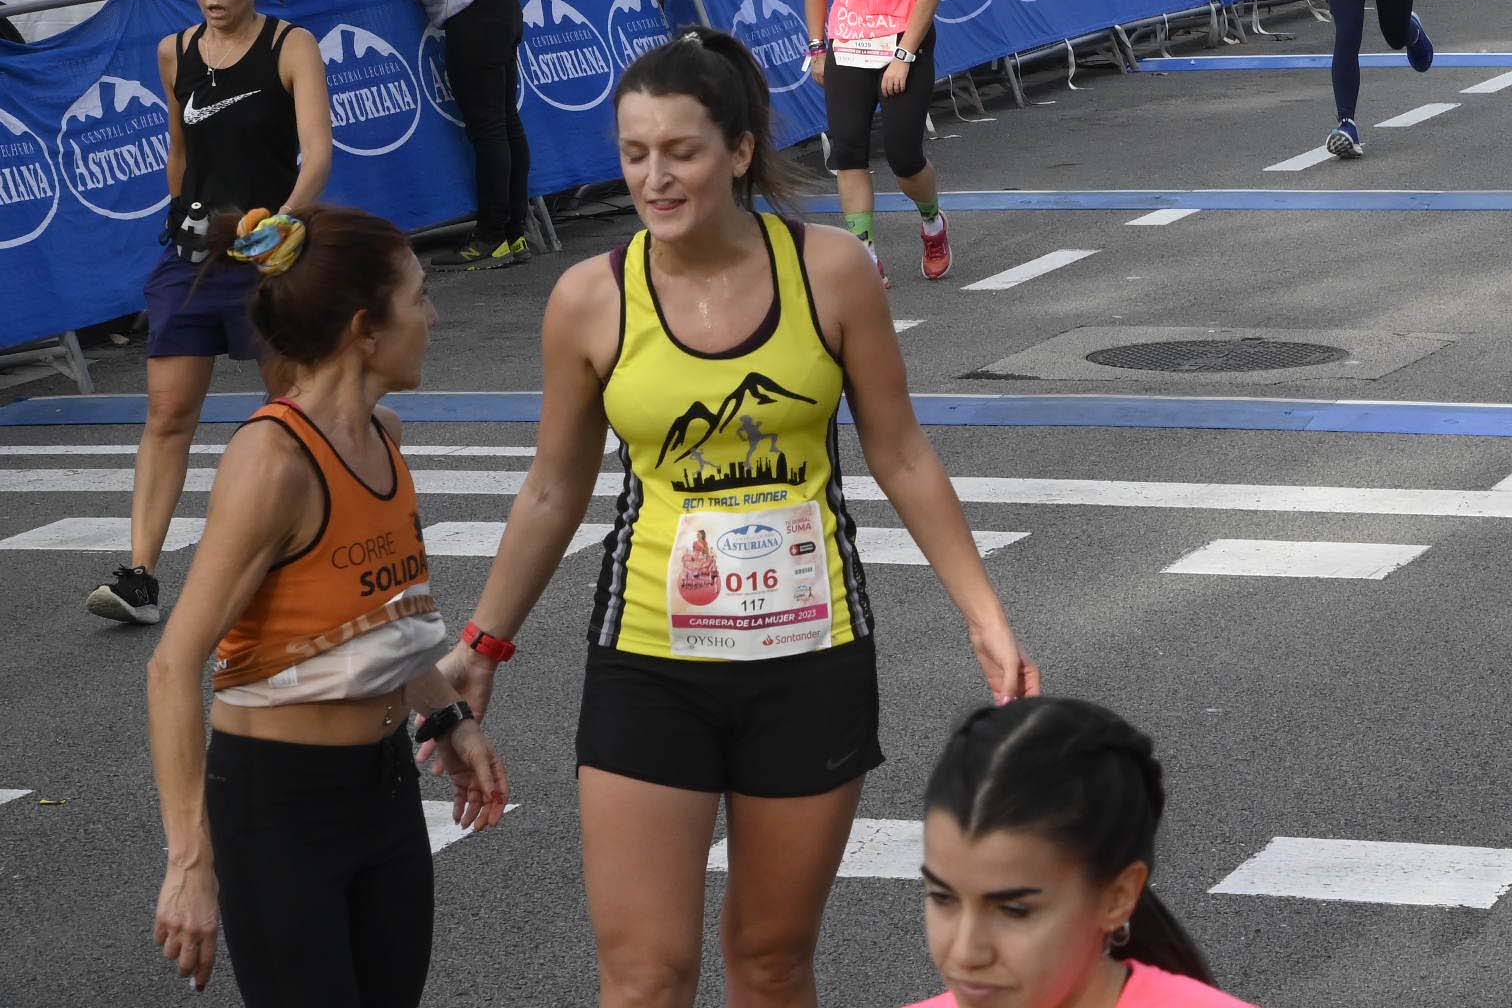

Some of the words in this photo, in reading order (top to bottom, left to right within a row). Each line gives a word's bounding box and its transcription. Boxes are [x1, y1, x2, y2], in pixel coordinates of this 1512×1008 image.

[524, 39, 610, 86] ASTURIANA
[683, 497, 705, 509] BCN
[708, 495, 741, 507] TRAIL
[743, 490, 788, 505] RUNNER
[786, 523, 812, 535] SUMA
[331, 532, 398, 570] CORRE
[722, 536, 779, 552] ASTURIANA
[725, 568, 779, 594] 016
[741, 597, 766, 613] 117
[689, 617, 735, 628] CARRERA
[736, 617, 750, 628] DE
[751, 615, 763, 626] LA
[764, 612, 795, 626] MUJER
[686, 634, 736, 650] OYSHO
[775, 629, 822, 646] Santander
